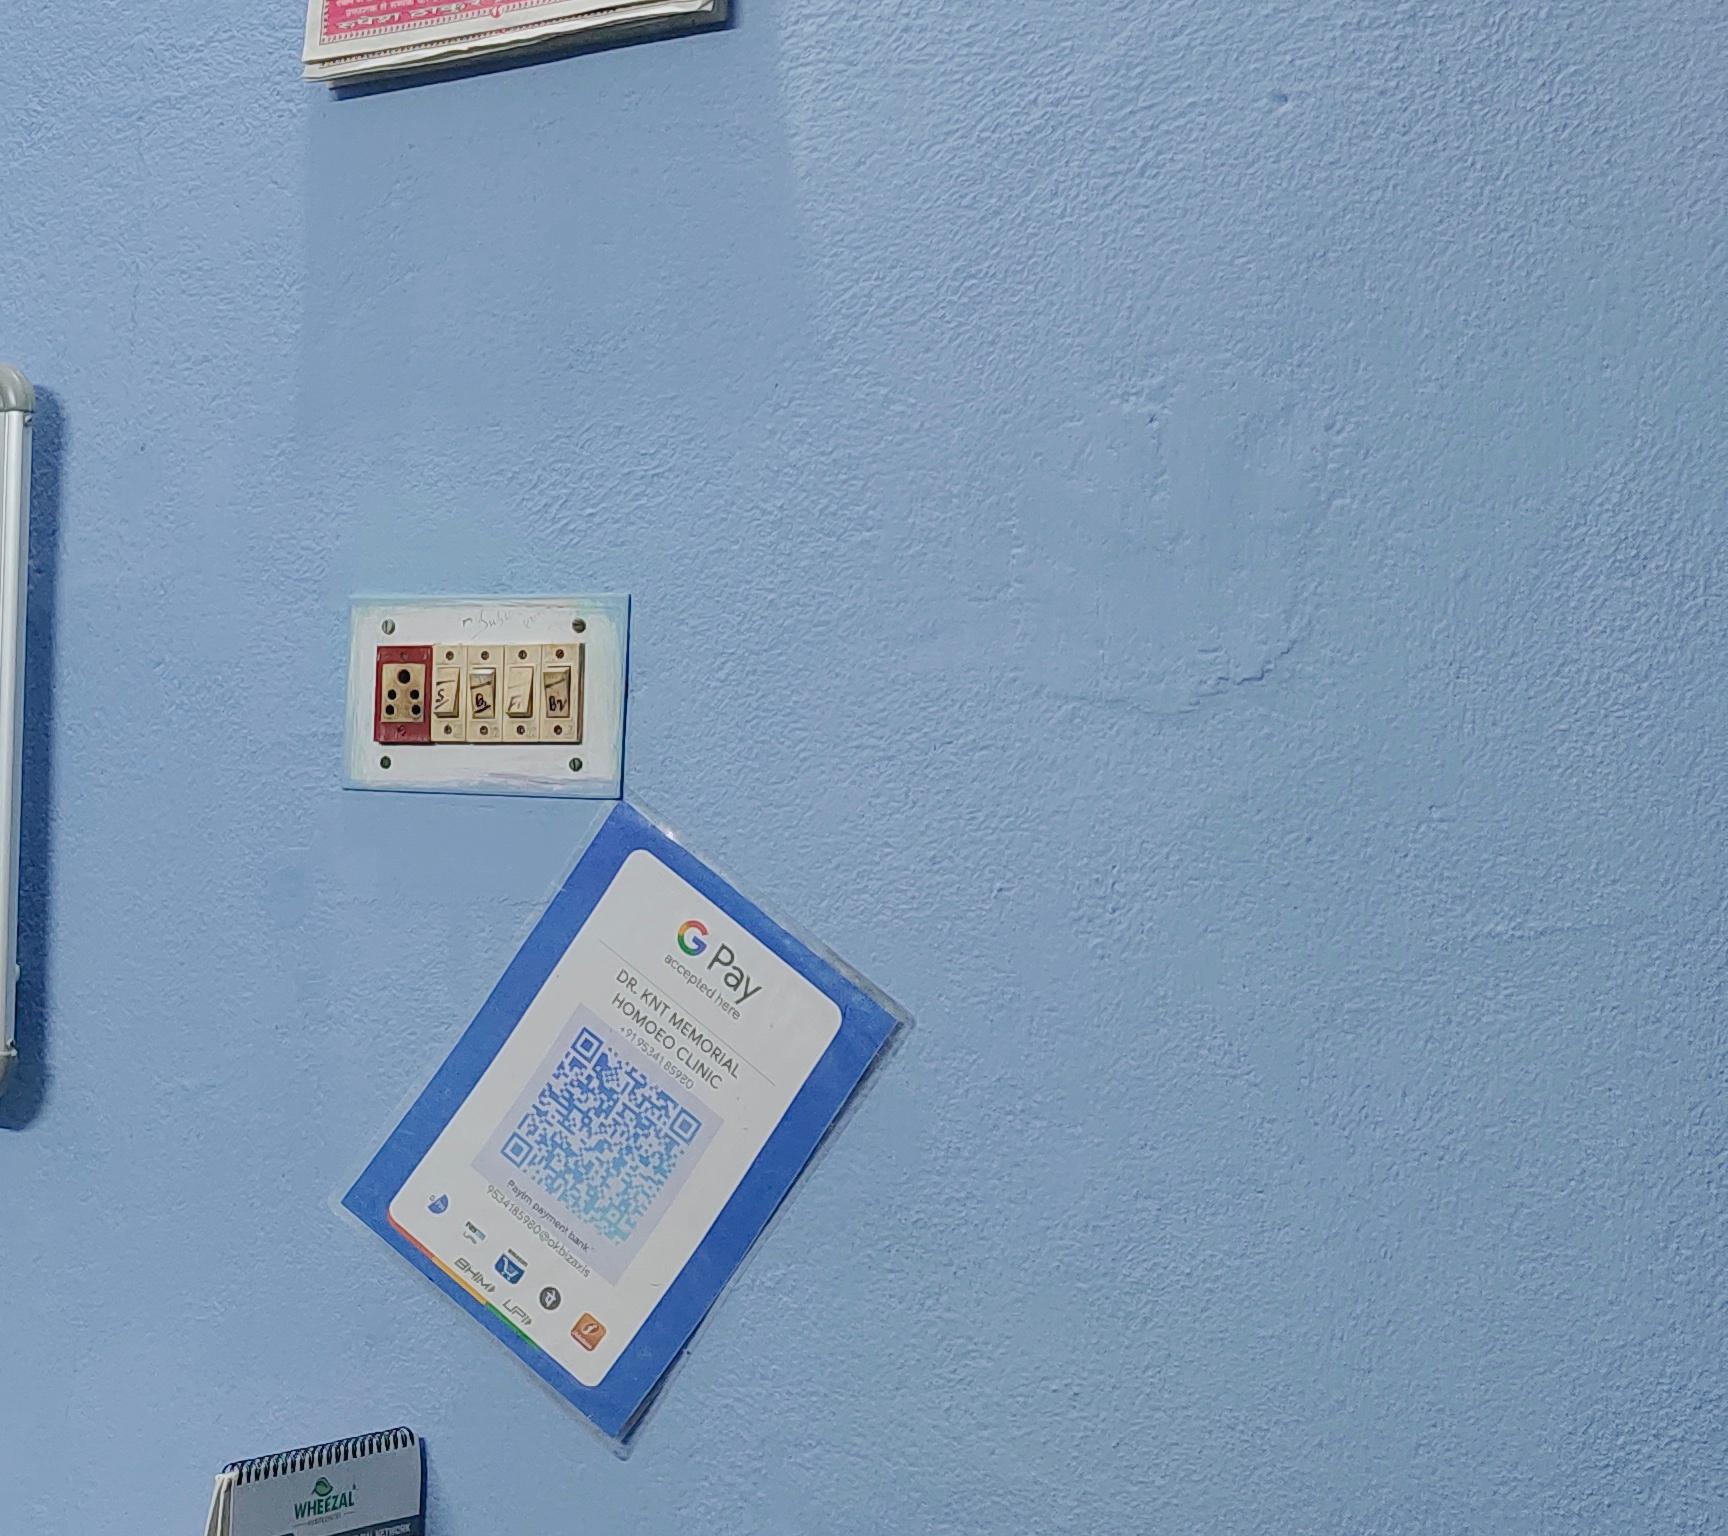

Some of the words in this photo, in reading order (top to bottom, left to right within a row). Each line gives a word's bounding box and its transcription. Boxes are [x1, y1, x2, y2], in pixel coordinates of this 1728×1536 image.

[664, 955, 716, 999] accepted
[714, 988, 741, 1020] here
[677, 920, 708, 956] G
[707, 943, 762, 1004] Pay
[612, 992, 676, 1049] HOMOEO
[676, 1046, 722, 1089] CLINIC
[616, 969, 638, 995] DR.
[640, 988, 670, 1016] KNT
[668, 1013, 740, 1080] MEMORIAL
[507, 1180, 533, 1208] Paytm
[532, 1199, 569, 1235] payment
[568, 1231, 589, 1252] bank
[454, 1258, 492, 1293] BHIM
[294, 1491, 354, 1519] WHEEZAL
